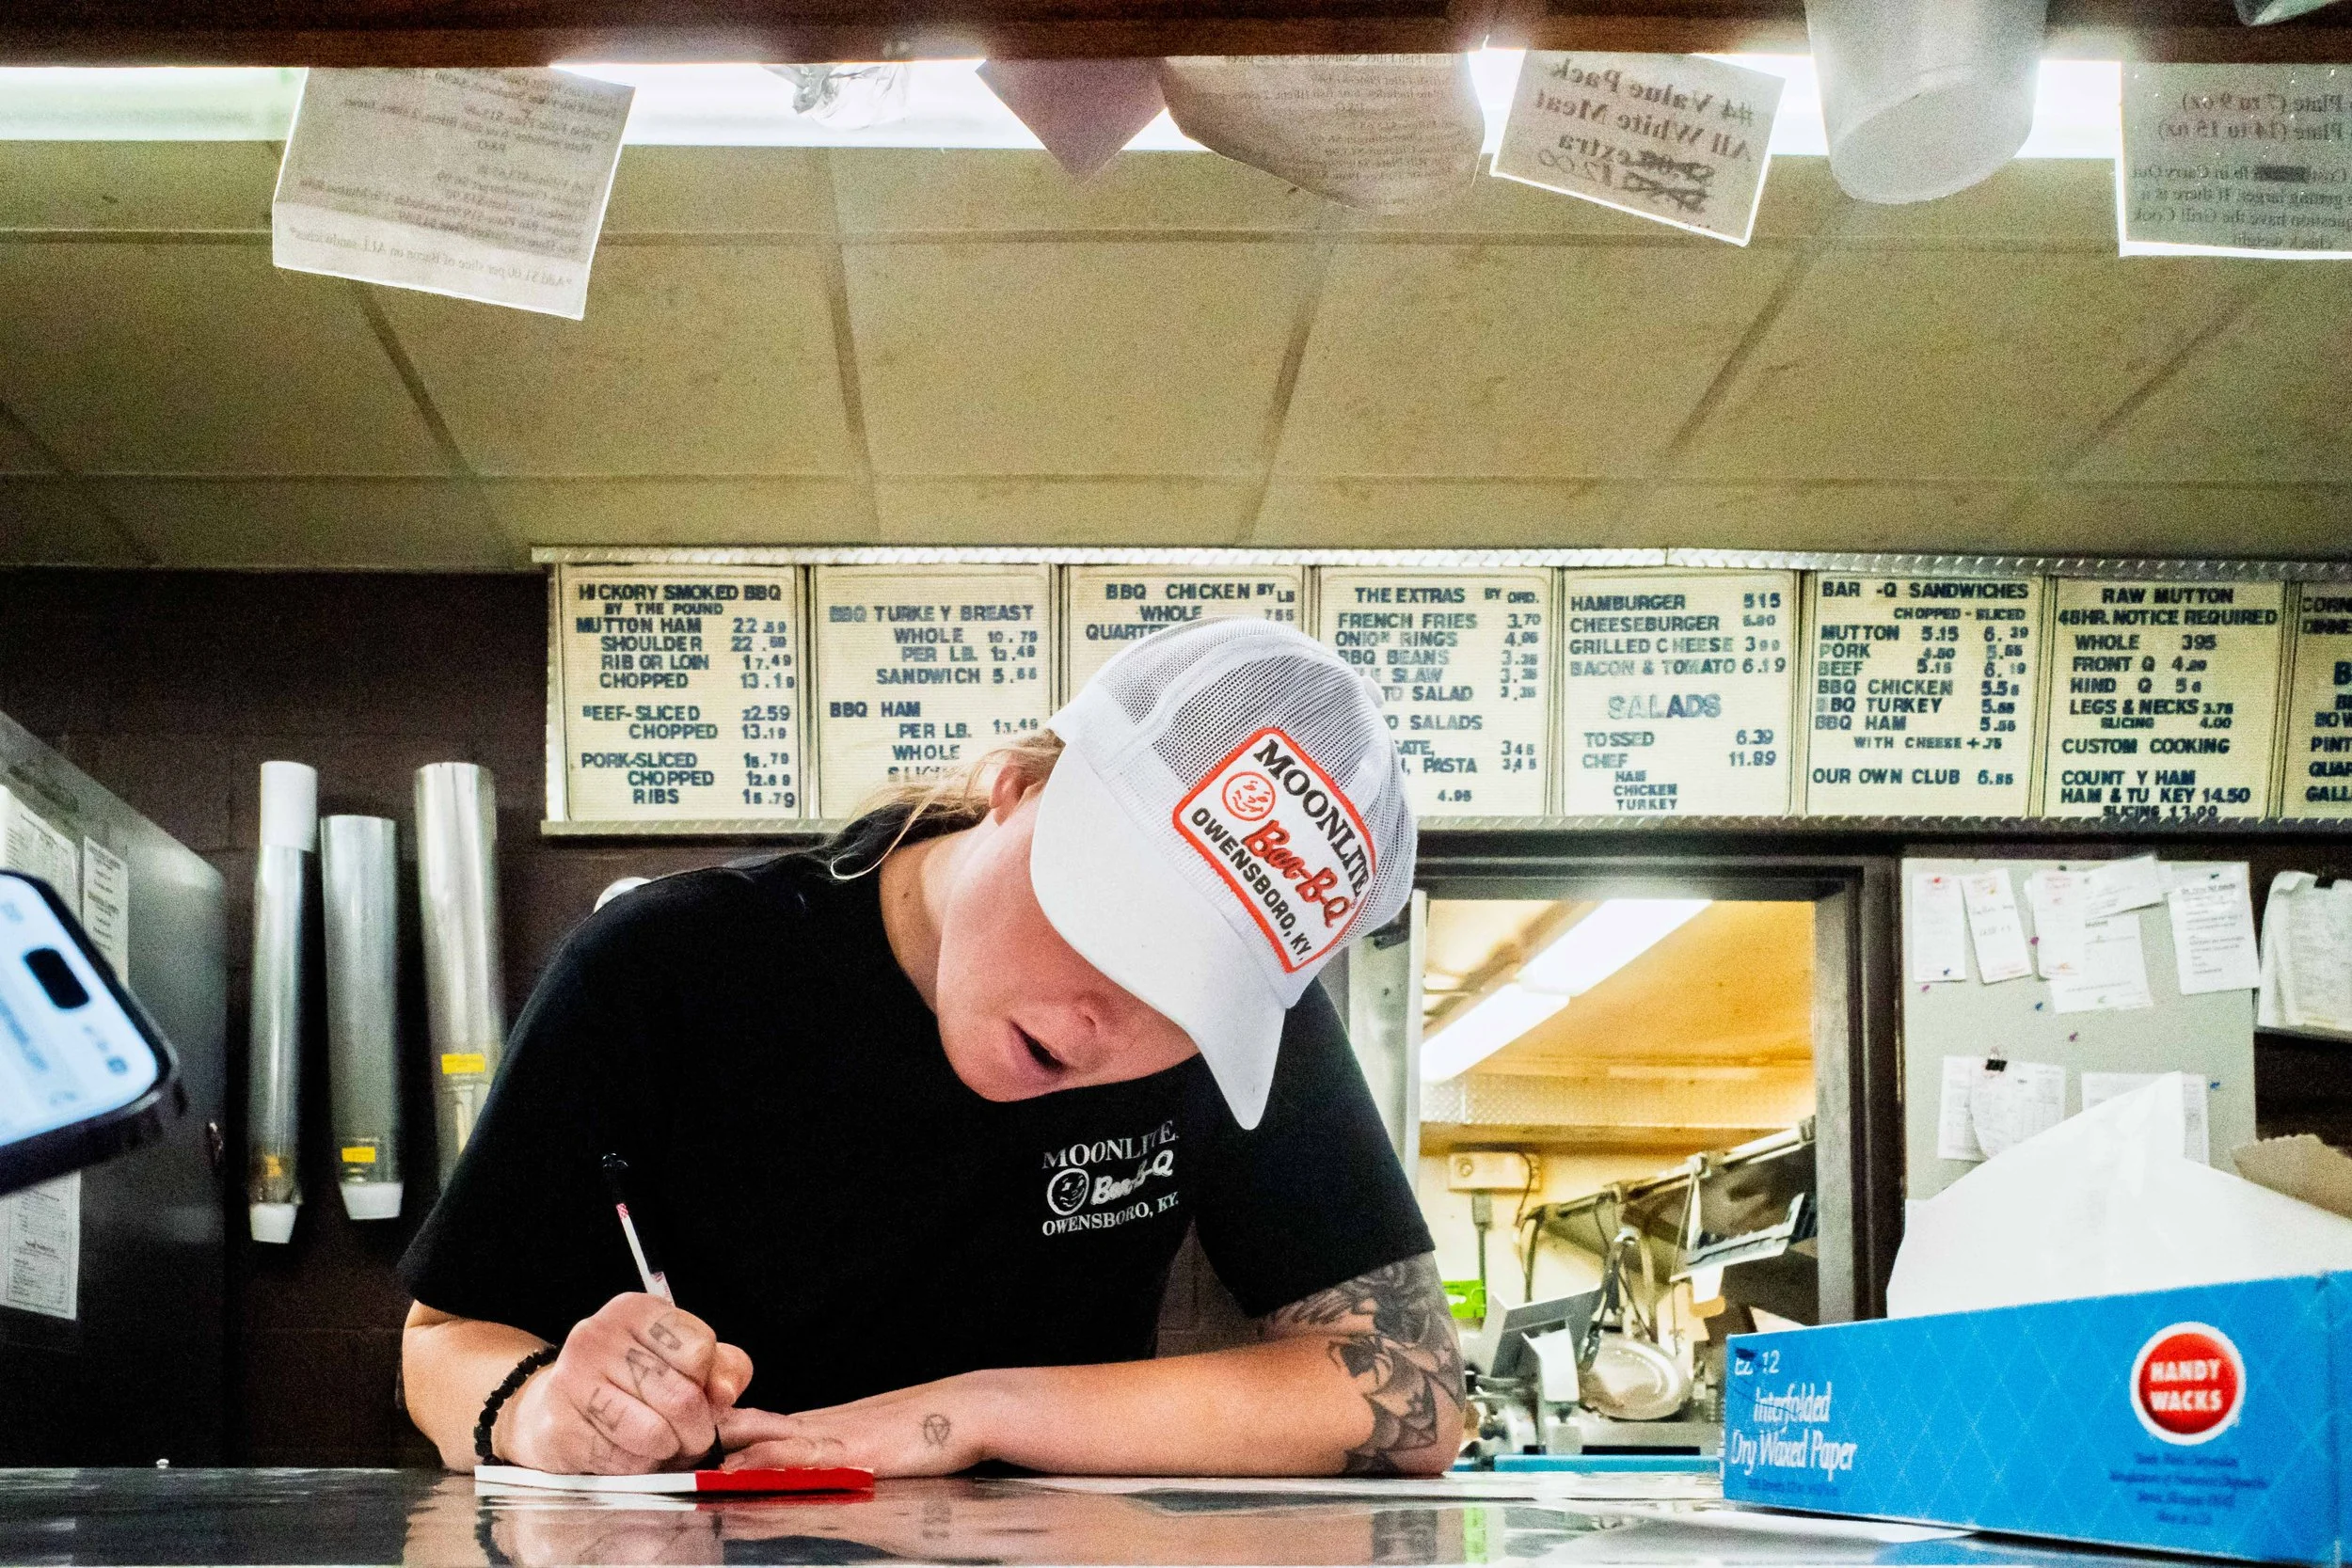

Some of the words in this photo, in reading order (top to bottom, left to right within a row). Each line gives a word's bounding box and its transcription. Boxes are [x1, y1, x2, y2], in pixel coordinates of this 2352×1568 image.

[580, 584, 659, 601] HICKORY
[663, 584, 739, 600] SMOKED
[744, 585, 781, 601] BBQ
[1105, 584, 1146, 599] BBQ
[1166, 583, 1249, 599] CHICKEN
[1257, 583, 1275, 595] BY
[1355, 588, 1391, 603] THE
[1396, 588, 1465, 603] EXTRAS
[1485, 588, 1502, 600] BY
[1821, 582, 1860, 596] BAR
[1910, 583, 2028, 598] SANDWICHES
[2102, 588, 2145, 603] RAW
[2154, 589, 2233, 604] MUTTON
[605, 603, 622, 615] BY
[636, 603, 664, 614] THE
[673, 603, 723, 615] POUND
[1570, 594, 1685, 611] HAMBURGER
[829, 606, 866, 622] BBQ
[874, 606, 951, 622] TURKEY
[961, 605, 1034, 621] BREAST
[1139, 606, 1202, 622] WHOLE
[1338, 613, 1412, 628] FRENCH
[1422, 613, 1478, 628] FRIES
[1894, 608, 1961, 620] CHOPPED
[1976, 609, 2026, 620] SLICED
[2113, 610, 2180, 625] NOTICE
[2185, 610, 2278, 625] REQUIRED
[576, 618, 653, 633] MUTTON
[660, 618, 702, 633] HAM
[1570, 615, 1719, 633] CHEESEBURGER
[894, 628, 963, 644] WHOLE
[1400, 631, 1458, 646] RINGS
[1821, 626, 1899, 641] MUTTON
[1921, 626, 1959, 641] 5.15
[601, 636, 702, 652] SHOULDER
[1570, 639, 1650, 655] GRILLED
[1657, 637, 1734, 653] CHEESE
[2074, 635, 2140, 650] WHOLE
[902, 647, 937, 662] PER
[1387, 650, 1450, 664] BEANS
[1820, 643, 1870, 658] PORK
[601, 655, 633, 670] RIB
[639, 655, 663, 670] OR
[671, 655, 709, 670] LOIN
[1570, 660, 1634, 676] BACON
[1643, 660, 1654, 674] &
[1662, 658, 1735, 674] TOMATO
[1818, 661, 1863, 676] BEEF
[2073, 657, 2133, 672] FRONT
[599, 673, 688, 689] CHOPPED
[876, 669, 980, 684] SANDWICH
[1392, 668, 1443, 683] SLAW
[1818, 680, 1856, 694] BBQ
[1867, 680, 1953, 695] CHICKEN
[2071, 678, 2116, 693] HIND
[1412, 686, 1472, 701] SALAD
[830, 702, 867, 717] BBQ
[881, 702, 920, 717] HAM
[1608, 694, 1721, 720] SALADS
[1818, 698, 1855, 713] BBQ
[1867, 698, 1943, 713] TURKEY
[2070, 700, 2117, 715] LEGS
[2122, 700, 2134, 715] &
[2139, 700, 2199, 715] NECKS
[1410, 715, 1483, 730] SALADS
[1815, 716, 1851, 730] BBQ
[1866, 716, 1906, 731] HAM
[2101, 718, 2154, 728] SLICING
[629, 724, 717, 739] CHOPPED
[899, 723, 935, 738] PER
[1584, 732, 1654, 747] TOSSED
[1736, 729, 1773, 745] 6.39
[1854, 737, 1894, 748] WITH
[1905, 737, 1962, 748] CHEESE
[2062, 738, 2137, 753] CUSTOM
[2150, 738, 2230, 753] COOKING
[2311, 736, 2352, 752] PINT
[892, 745, 960, 760] WHOLE
[1423, 758, 1478, 772] PASTA
[1582, 753, 1629, 768] CHEF
[628, 771, 714, 786] CHOPPED
[1615, 770, 1646, 782] HAM
[1812, 768, 1851, 784] OUR
[1859, 768, 1902, 784] OWN
[1912, 769, 1960, 784] CLUB
[2155, 770, 2196, 784] HAM
[633, 789, 679, 803] RIBS
[1613, 784, 1677, 796] CHICKEN
[2061, 788, 2102, 803] HAM
[2110, 788, 2121, 802] &
[1617, 800, 1677, 810] TURKEY
[1253, 739, 1370, 896] MOONLITE
[1191, 808, 1296, 937] OWENSBORO,
[1041, 1120, 1176, 1169] MOONLITE
[1042, 1202, 1153, 1236] OWENSBORO,
[1157, 1192, 1178, 1212] KY.
[2151, 1359, 2220, 1382] HANDY
[1754, 1381, 1832, 1433] Interfolded
[2150, 1390, 2221, 1411] WACKS
[1731, 1430, 1756, 1476] Dry
[1760, 1428, 1808, 1467] Waxed
[1810, 1430, 1857, 1481] Paper
